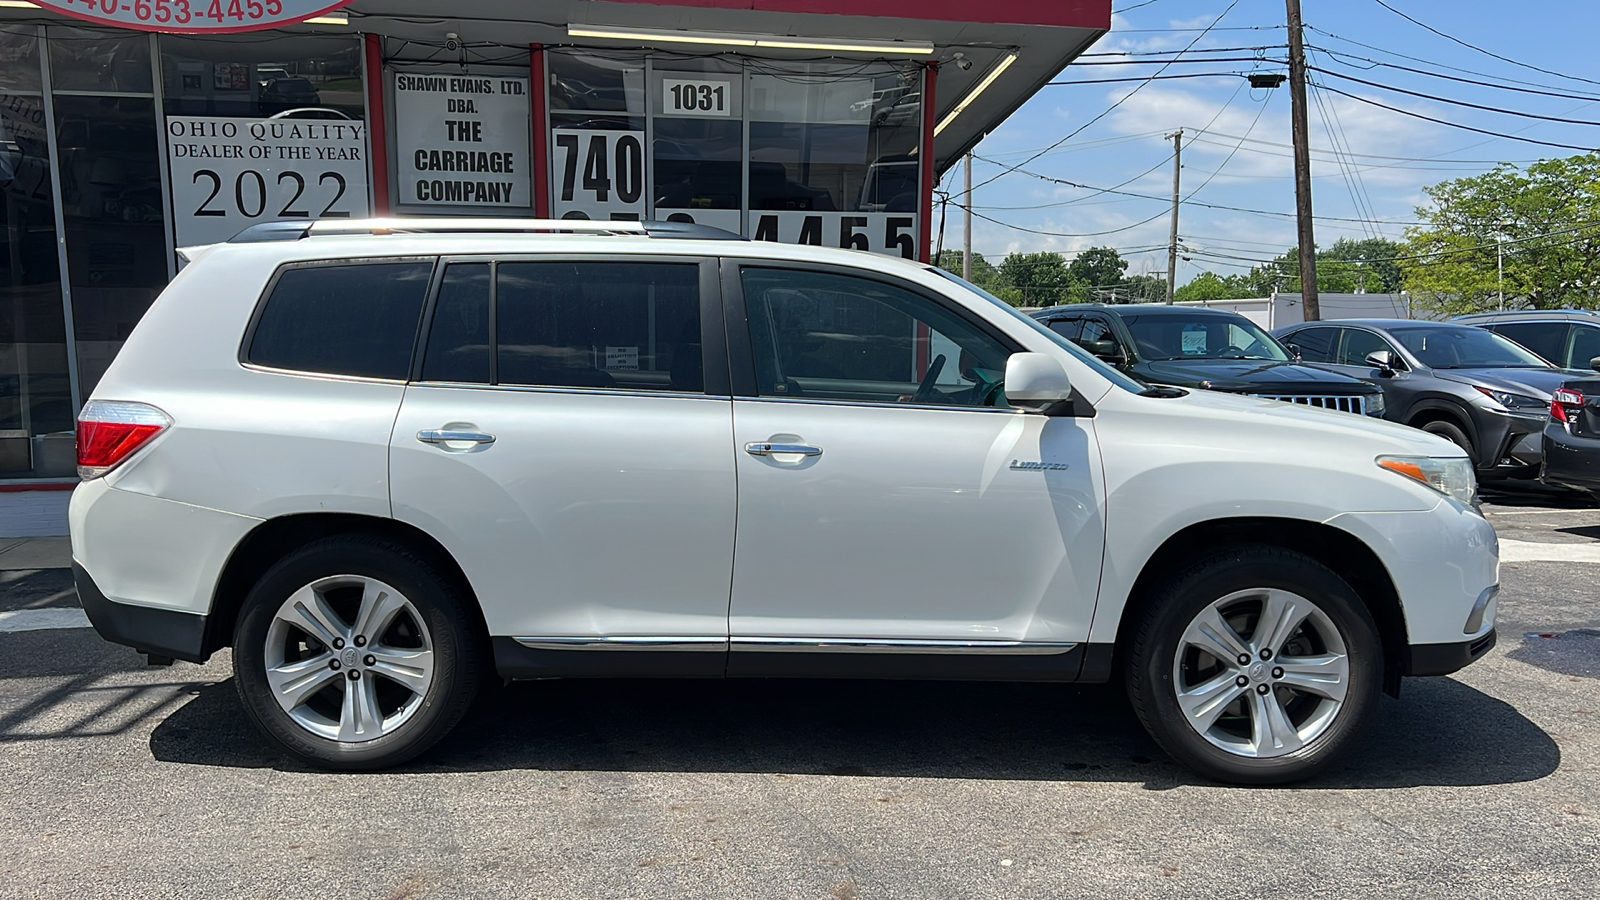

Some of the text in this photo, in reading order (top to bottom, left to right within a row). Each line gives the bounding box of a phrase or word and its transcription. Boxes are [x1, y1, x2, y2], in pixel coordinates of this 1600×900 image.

[66, 0, 282, 24] 0-653-4455
[397, 76, 526, 95] SHAWN EVANS. LTD.
[670, 84, 724, 111] 1031
[447, 98, 478, 113] DBA.
[170, 121, 362, 142] OHIO QUALITY
[445, 120, 482, 142] THE
[174, 143, 361, 161] DEALER OF THE YEAR
[414, 149, 514, 174] CARRIAGE
[556, 134, 642, 204] 740
[192, 169, 351, 218] 2022
[416, 179, 514, 203] COMPANY
